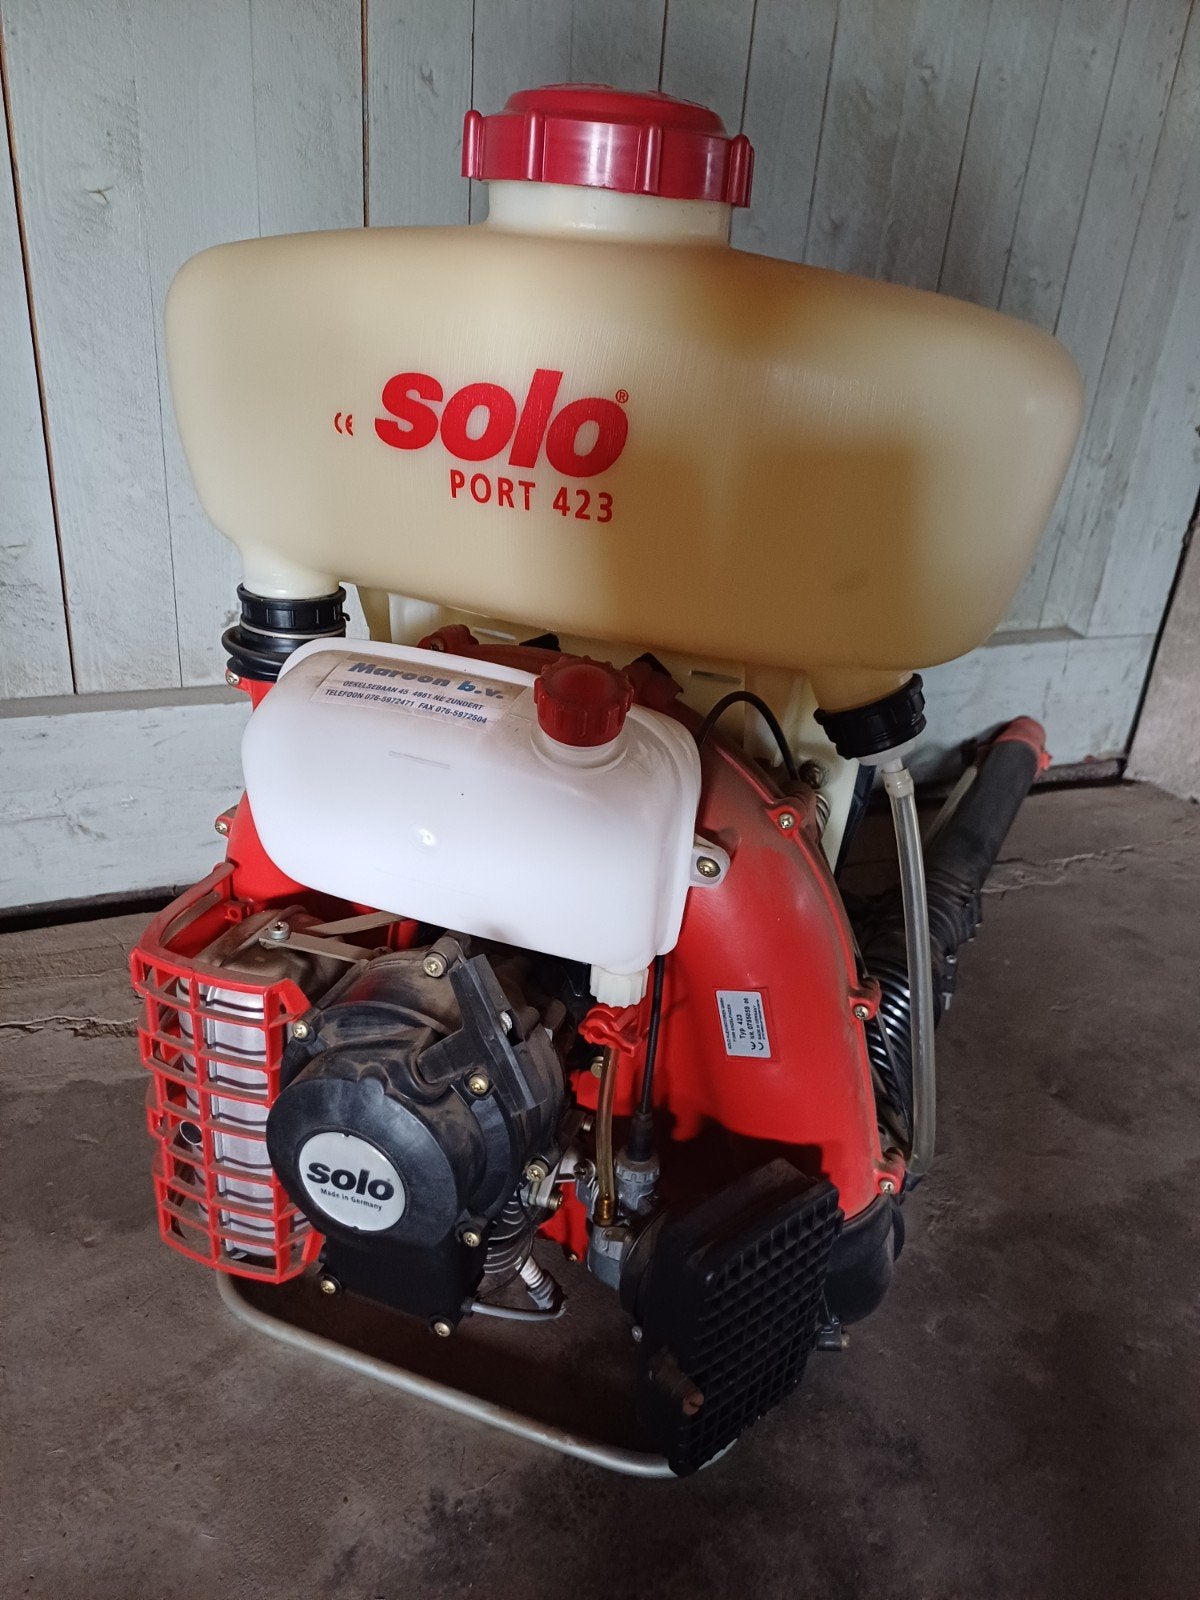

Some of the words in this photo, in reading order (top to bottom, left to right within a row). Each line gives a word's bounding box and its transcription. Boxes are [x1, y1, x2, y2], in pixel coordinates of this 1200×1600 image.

[450, 469, 536, 511] PORT
[552, 486, 614, 523] 423
[348, 662, 451, 687] Maroon
[457, 681, 504, 699] b.v.
[325, 689, 364, 699] TELEFOON
[364, 693, 415, 707] 076-5972471
[417, 702, 436, 711] FAX
[435, 706, 488, 723] 076-5972504
[446, 697, 484, 710] ZUNDERT
[306, 1162, 395, 1201] solo
[320, 1188, 340, 1198] Made
[341, 1193, 349, 1201] in
[350, 1196, 382, 1212] Germany
